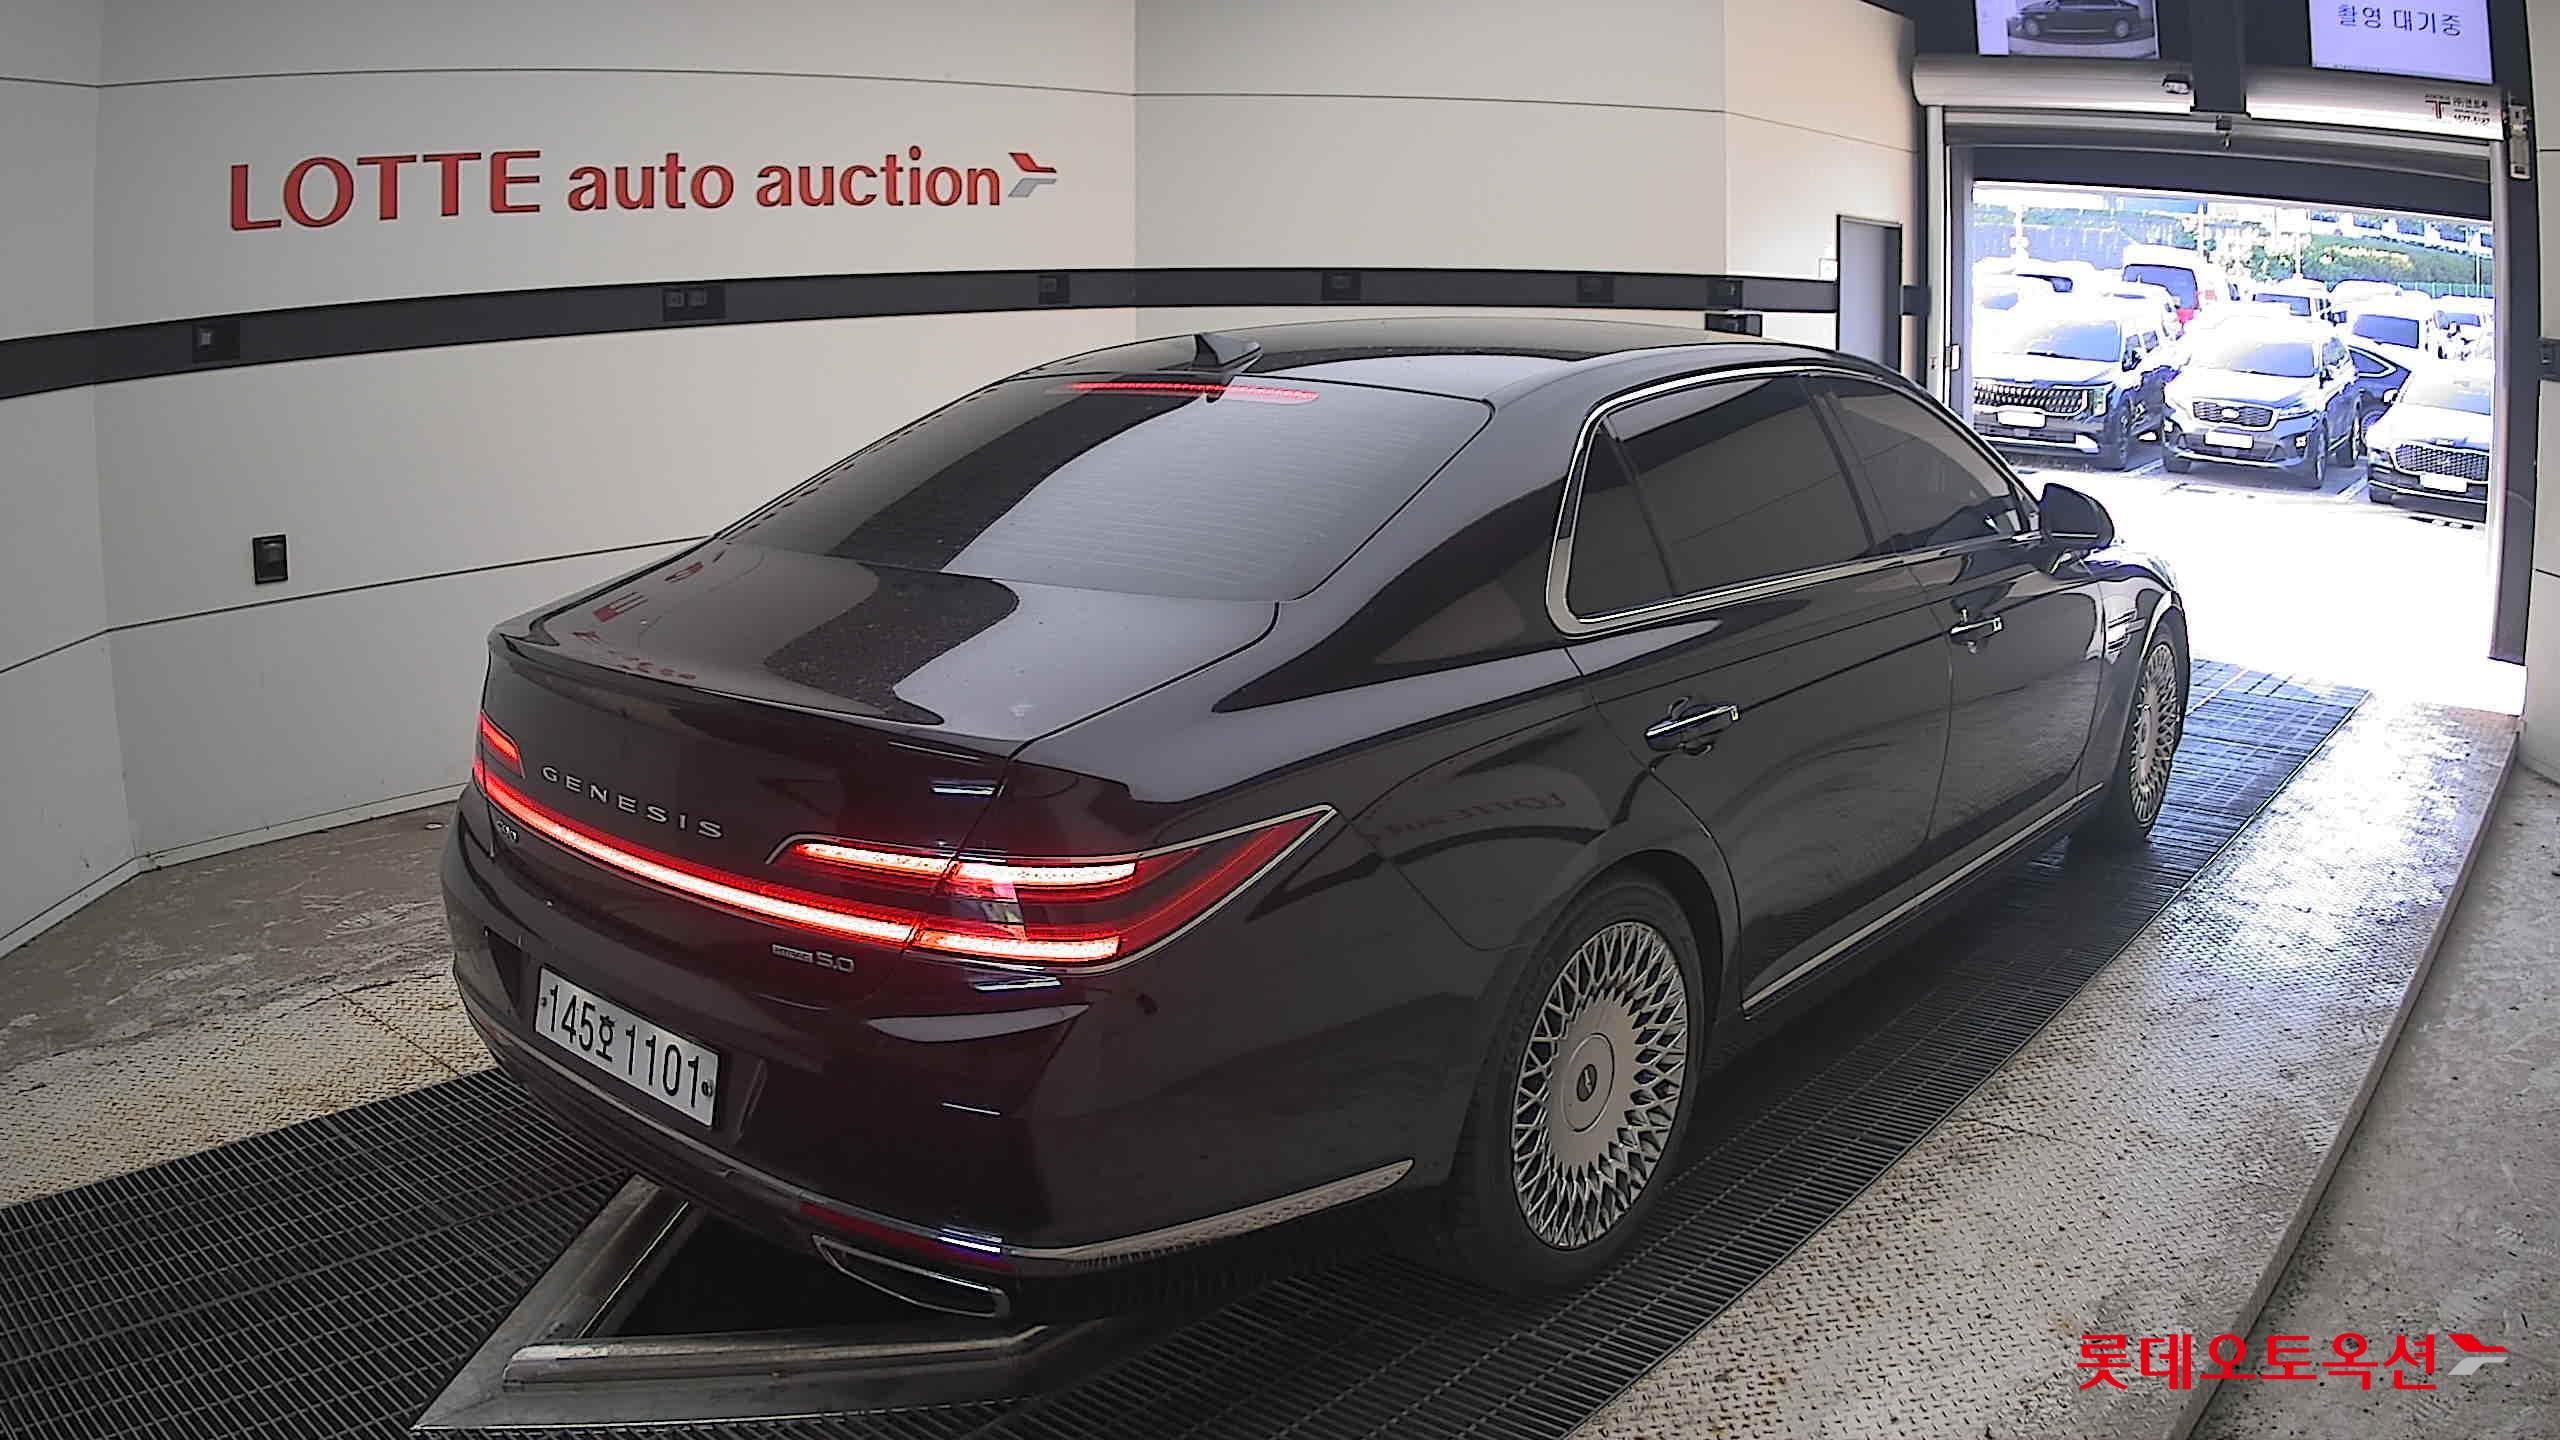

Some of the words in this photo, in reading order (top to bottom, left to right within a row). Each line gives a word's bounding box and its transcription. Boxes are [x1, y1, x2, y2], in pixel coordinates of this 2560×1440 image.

[2338, 5, 2382, 29] 촬영
[2393, 9, 2462, 37] 대기중
[231, 151, 541, 231] LOTTE
[568, 152, 735, 210] auto
[757, 146, 1002, 206] auction
[542, 766, 722, 838] GENESIS
[816, 951, 855, 973] 5.0
[550, 984, 616, 1062] 145호
[625, 1025, 699, 1108] 1101
